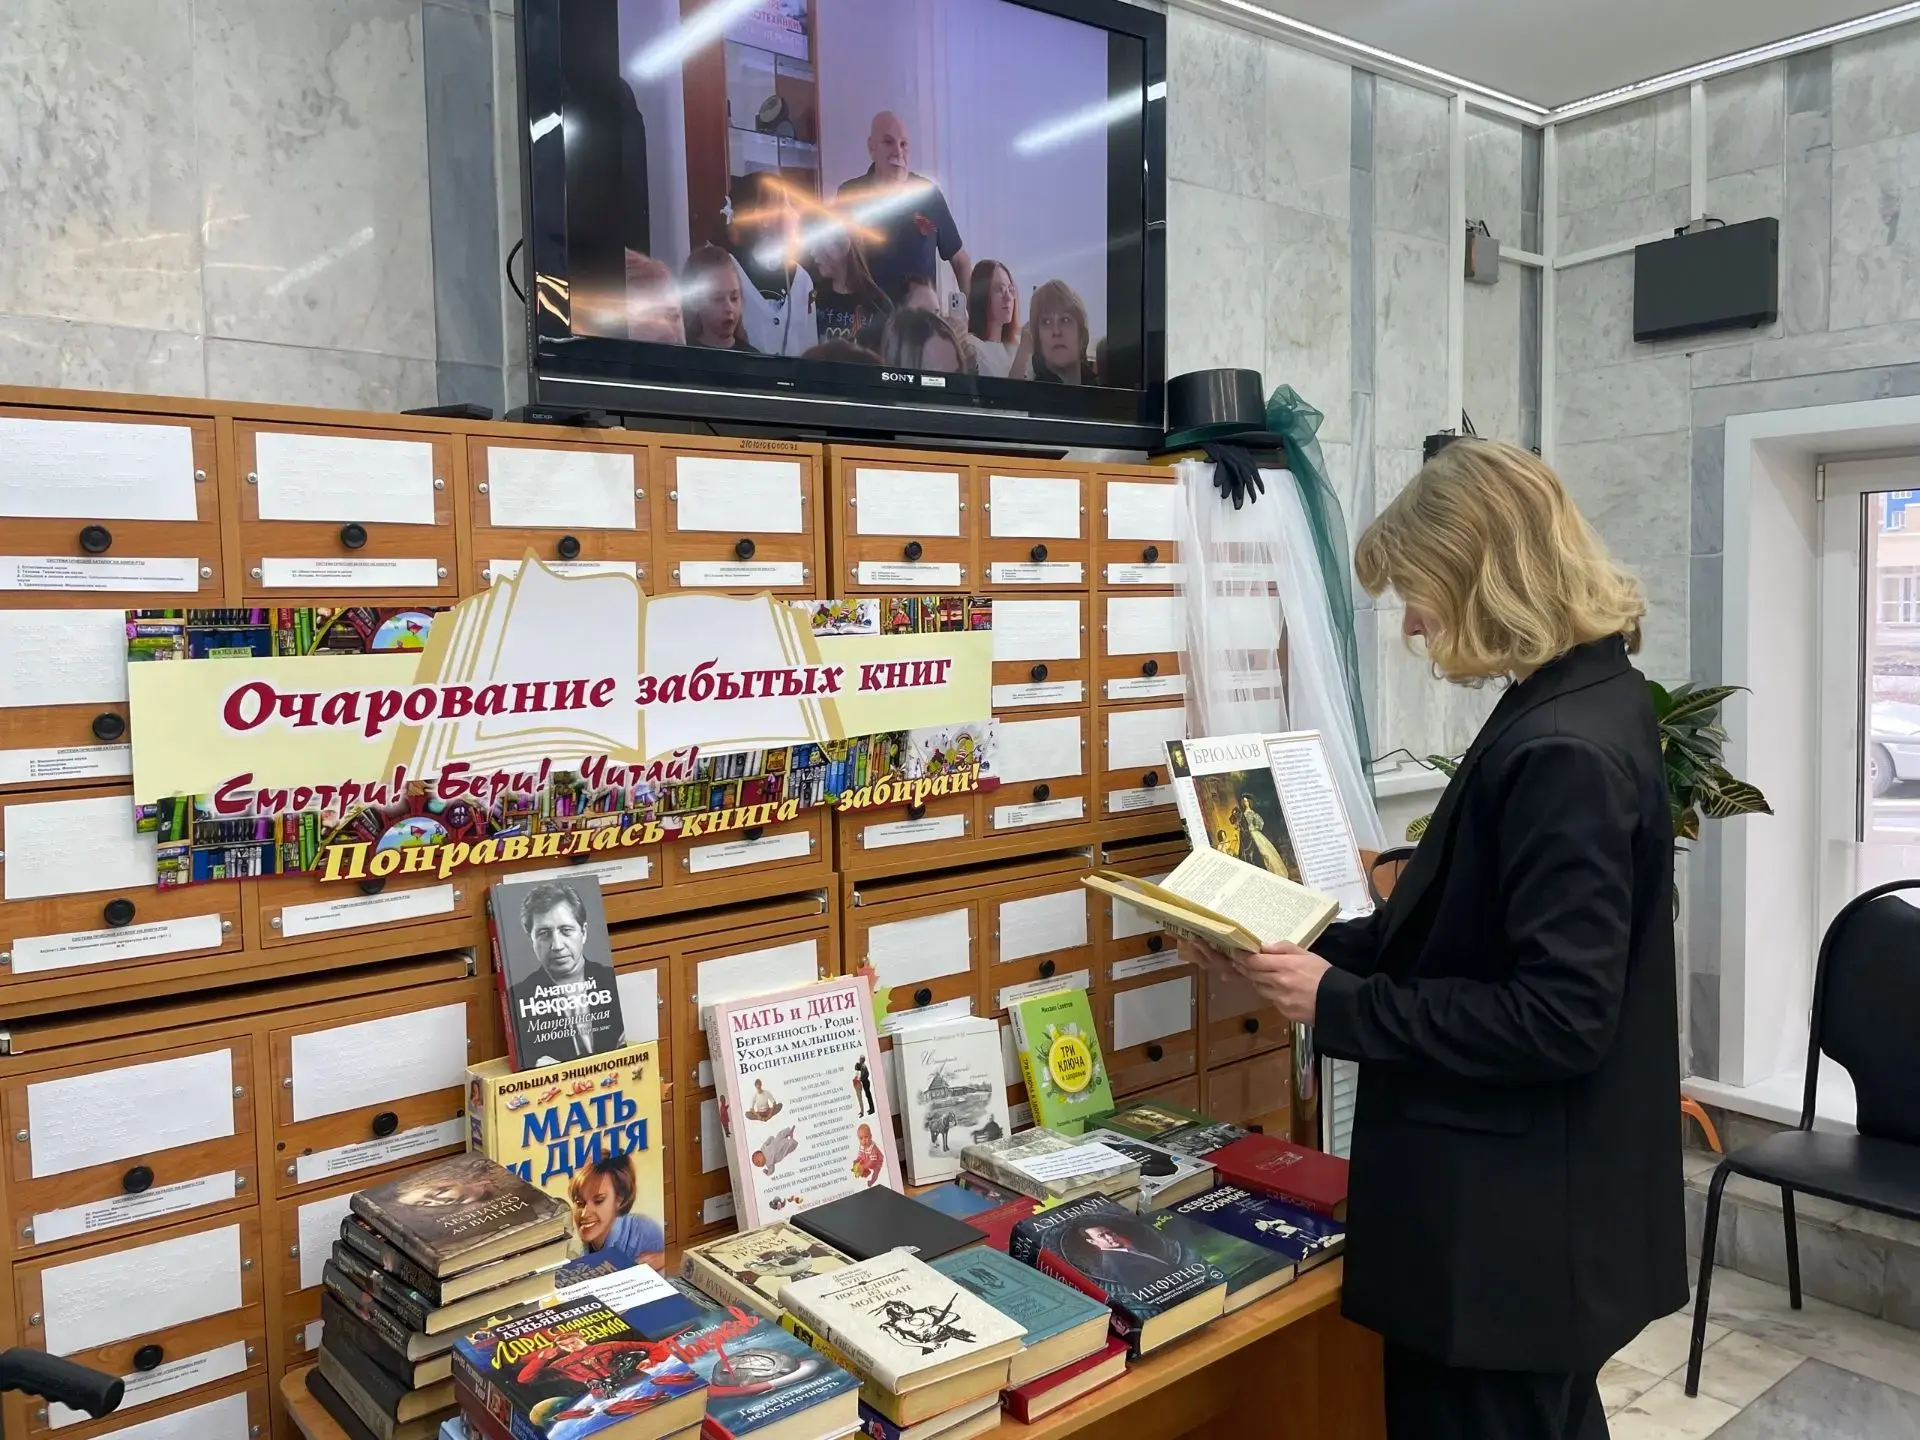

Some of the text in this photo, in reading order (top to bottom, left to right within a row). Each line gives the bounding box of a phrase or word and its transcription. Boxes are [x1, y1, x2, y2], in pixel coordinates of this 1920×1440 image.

[881, 371, 915, 383] SONY
[223, 657, 952, 737] Очарование забытых книг
[1193, 743, 1261, 764] БРЮЛЛОВ
[213, 746, 699, 819] Смотри! Бери! Читай!
[320, 817, 666, 883] Понравилась
[677, 797, 800, 843] книга
[838, 763, 981, 811] забирай!
[534, 976, 597, 999] Анатолий
[519, 989, 613, 1018] Некрасов
[732, 1007, 785, 1032] МАТЬ
[807, 991, 856, 1021] ДИТЯ
[527, 1010, 611, 1033] Материнская
[533, 1028, 577, 1044] любовь
[791, 1028, 857, 1050] МАЛЫШОМ
[1060, 1044, 1076, 1056] ТРИ
[498, 1051, 650, 1096] БОЛЬШАЯ ЭНЦИКЛОПЕДИЯ
[1057, 1056, 1085, 1073] КЛЮЧА
[521, 1090, 638, 1148] МАТЬ
[506, 1118, 648, 1186] И ДИТЯ
[444, 1196, 520, 1229] ЛЕОНАРДО
[1177, 1184, 1239, 1213] СЕВЕРНОЕ
[1201, 1189, 1252, 1213] СИЯНИЕ
[468, 1200, 529, 1228] ВИНЧИ
[1032, 1196, 1111, 1233] ДЭН БРАУН
[834, 1274, 901, 1301] ПОСЛЕДНИЙ
[1132, 1262, 1206, 1302] ИНФЕРНО
[849, 1284, 912, 1310] МОГИКАН
[496, 1308, 557, 1333] СЕРГЕЙ
[501, 1302, 602, 1340] ЛУКЬЯНЕНКО
[678, 1323, 720, 1342] Юрий
[738, 1375, 833, 1418] Государственная
[747, 1381, 840, 1422] недостаточность
